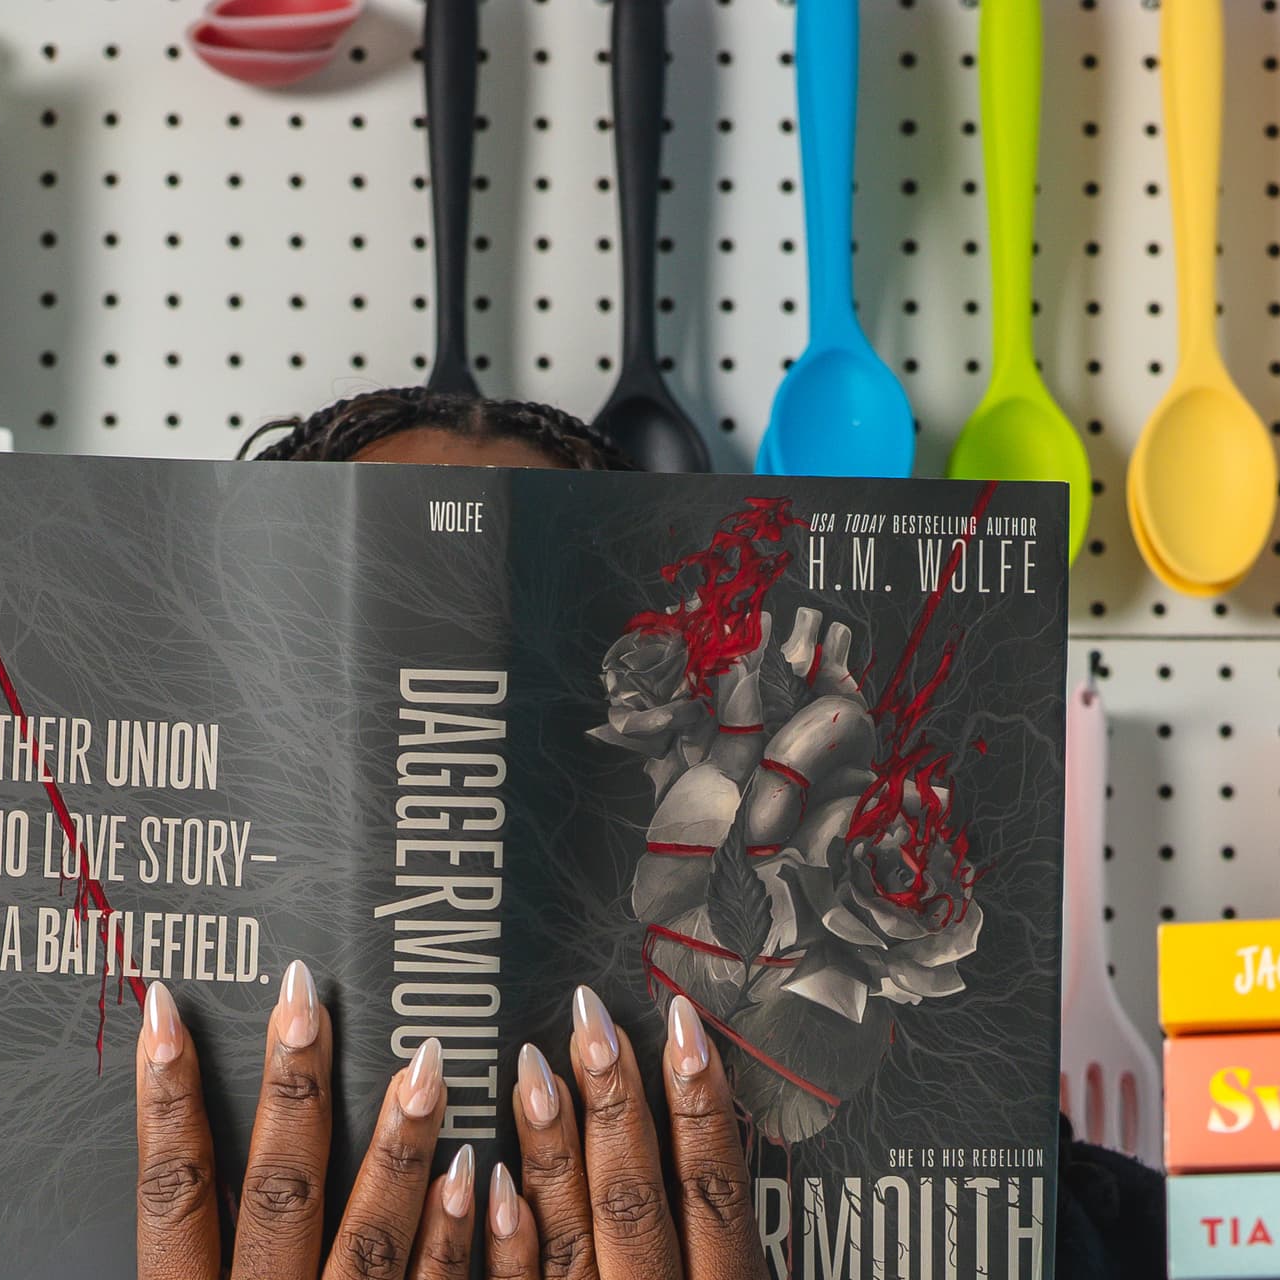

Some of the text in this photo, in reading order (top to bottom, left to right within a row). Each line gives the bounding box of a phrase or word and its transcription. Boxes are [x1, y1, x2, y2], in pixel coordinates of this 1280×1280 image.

[429, 501, 484, 533] WOLFE
[809, 513, 1037, 537] USA TODAY BESTSELLING AUTHOR
[809, 536, 1037, 594] H.M. WOLFE
[105, 719, 219, 790] UNION
[43, 811, 127, 882] LOVE
[0, 905, 23, 973] A
[36, 907, 270, 985] BATTLEFIELD.
[889, 1148, 1045, 1168] SHE IS HIS REBELLION
[1201, 1216, 1275, 1248] TIA
